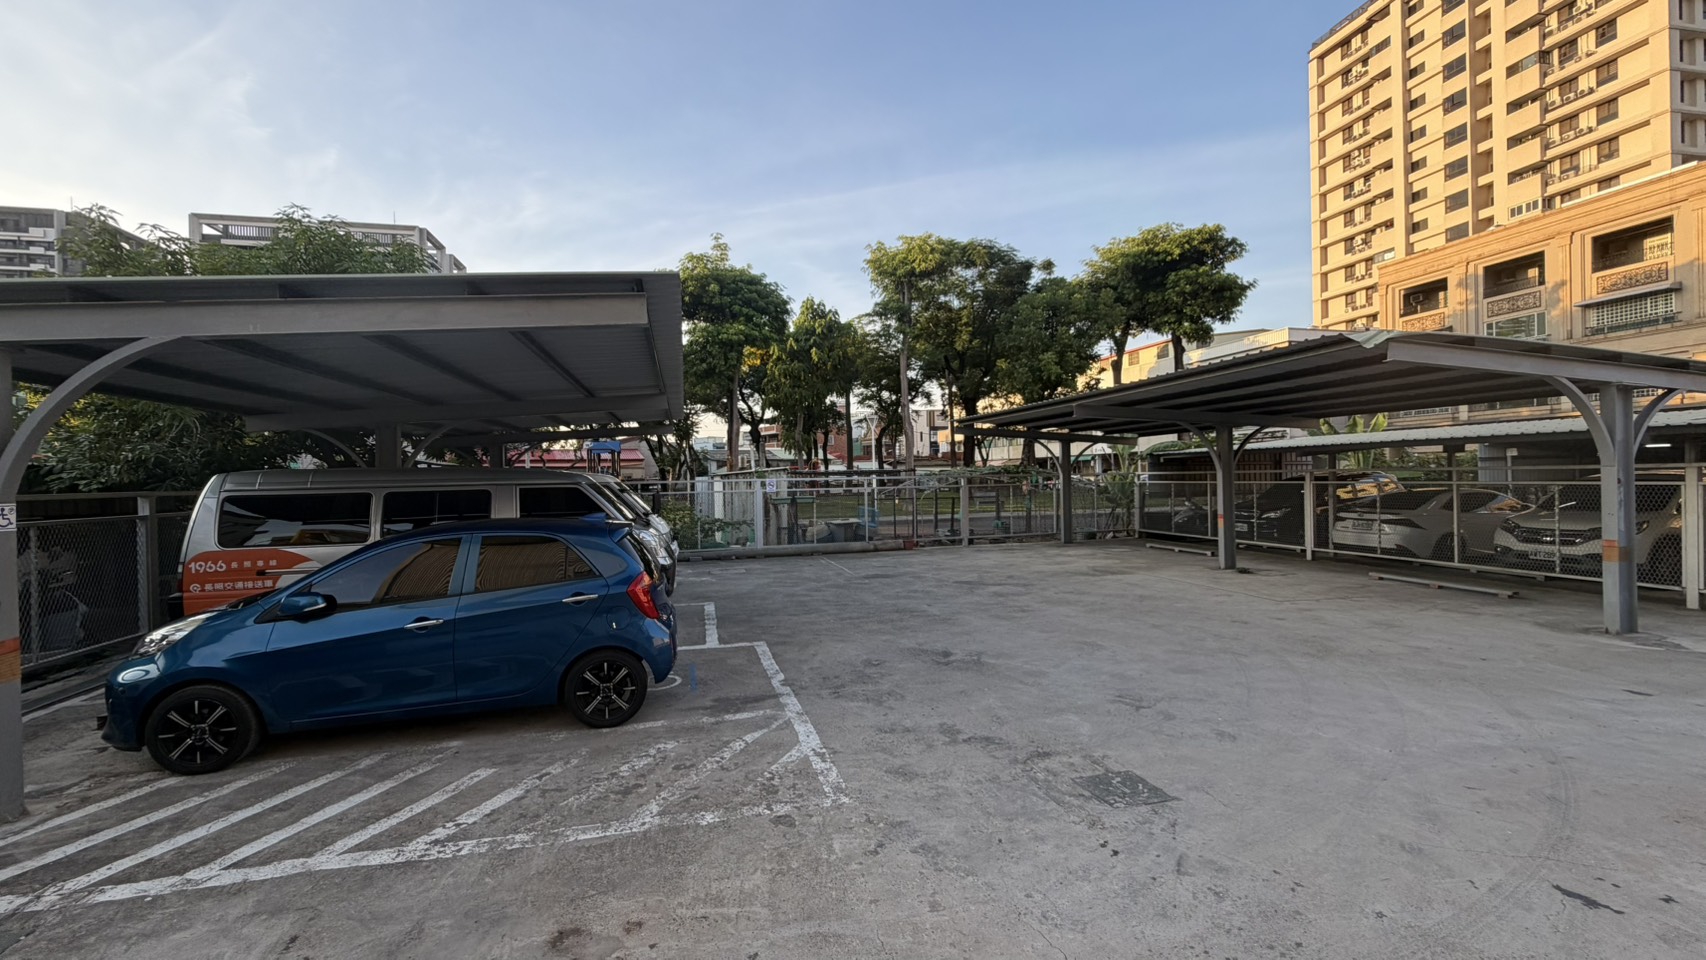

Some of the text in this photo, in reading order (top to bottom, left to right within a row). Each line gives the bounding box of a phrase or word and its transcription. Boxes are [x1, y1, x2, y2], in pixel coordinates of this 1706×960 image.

[188, 560, 226, 574] 1966
[204, 580, 274, 592] 長照交通接送車
